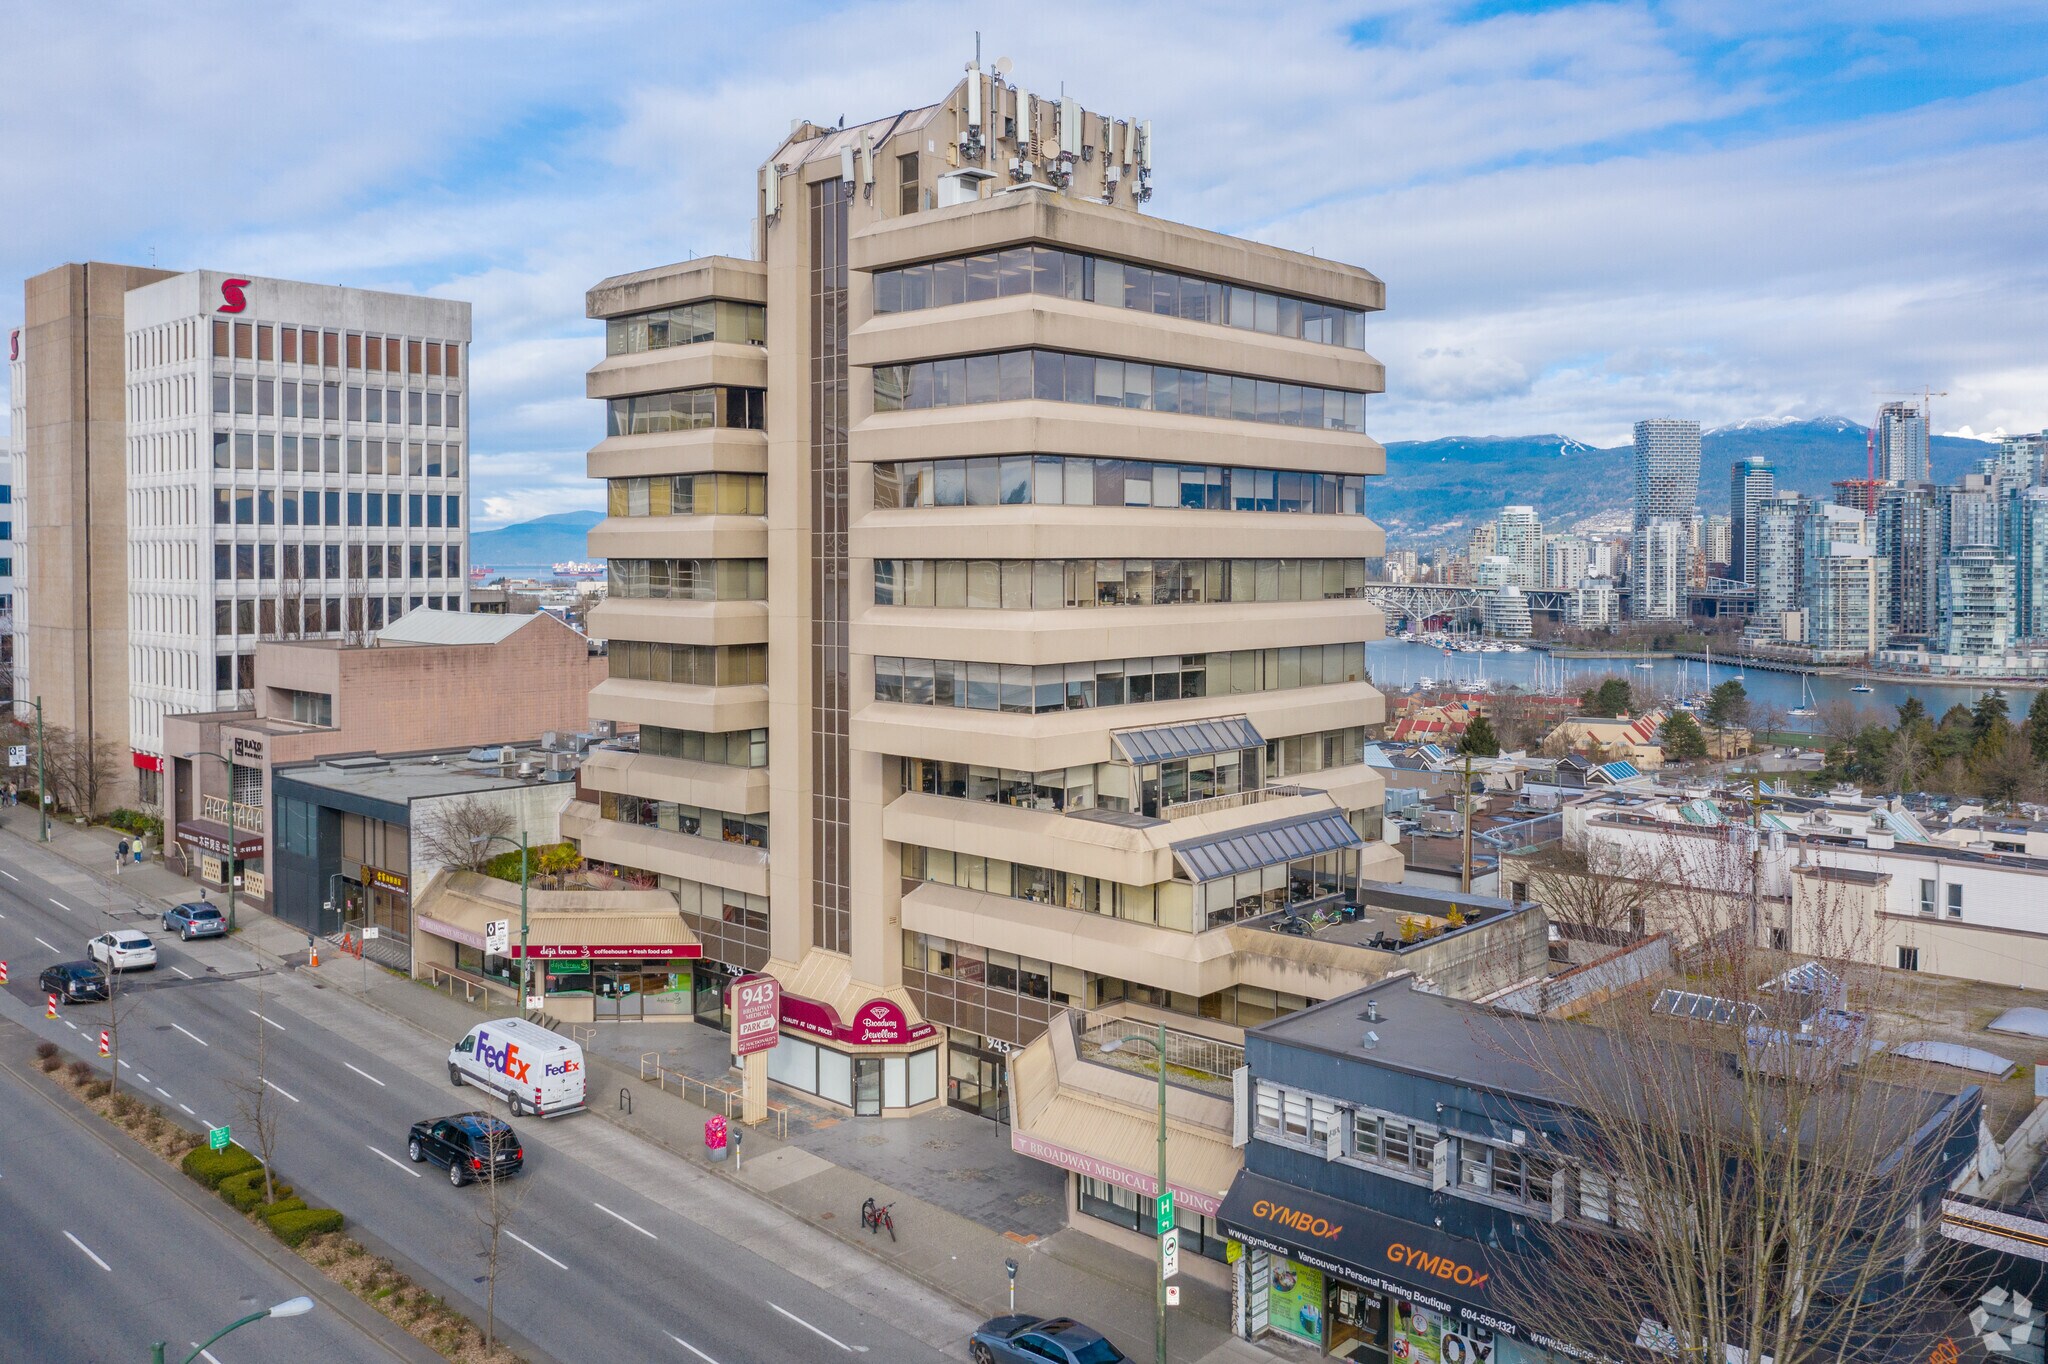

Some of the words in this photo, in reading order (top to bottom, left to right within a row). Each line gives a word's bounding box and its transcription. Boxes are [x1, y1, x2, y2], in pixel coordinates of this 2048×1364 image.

[558, 945, 577, 955] brew
[726, 964, 744, 976] 943
[742, 983, 774, 1007] 943
[742, 1003, 772, 1015] BROADWAY
[745, 1010, 770, 1020] MEDICAL
[742, 1022, 761, 1034] PARK
[782, 1016, 798, 1026] QUALITY
[807, 1022, 816, 1032] LOW
[818, 1026, 832, 1036] PRICES
[862, 1018, 897, 1029] Broadway
[861, 1028, 898, 1041] Jewellers
[912, 1027, 931, 1038] REPAIRS
[987, 1037, 1011, 1053] 943
[475, 1030, 531, 1084] FedEx
[545, 1059, 580, 1077] FedEx
[1030, 1142, 1092, 1173] BROADWAY
[1095, 1162, 1149, 1192] MEDICAL
[1152, 1179, 1214, 1213] BILDING
[1161, 1199, 1170, 1215] H
[1252, 1199, 1343, 1241] GYMBOX
[1386, 1242, 1489, 1290] GYMBOX
[1228, 1227, 1288, 1256] www.gymbox.ca
[1298, 1250, 1344, 1275] Vancouver's
[1345, 1263, 1380, 1287] Personal
[1380, 1280, 1412, 1301] Training
[1413, 1291, 1452, 1313] Boutique
[1461, 1307, 1516, 1335] 604-559-1321
[1367, 1298, 1381, 1309] 909
